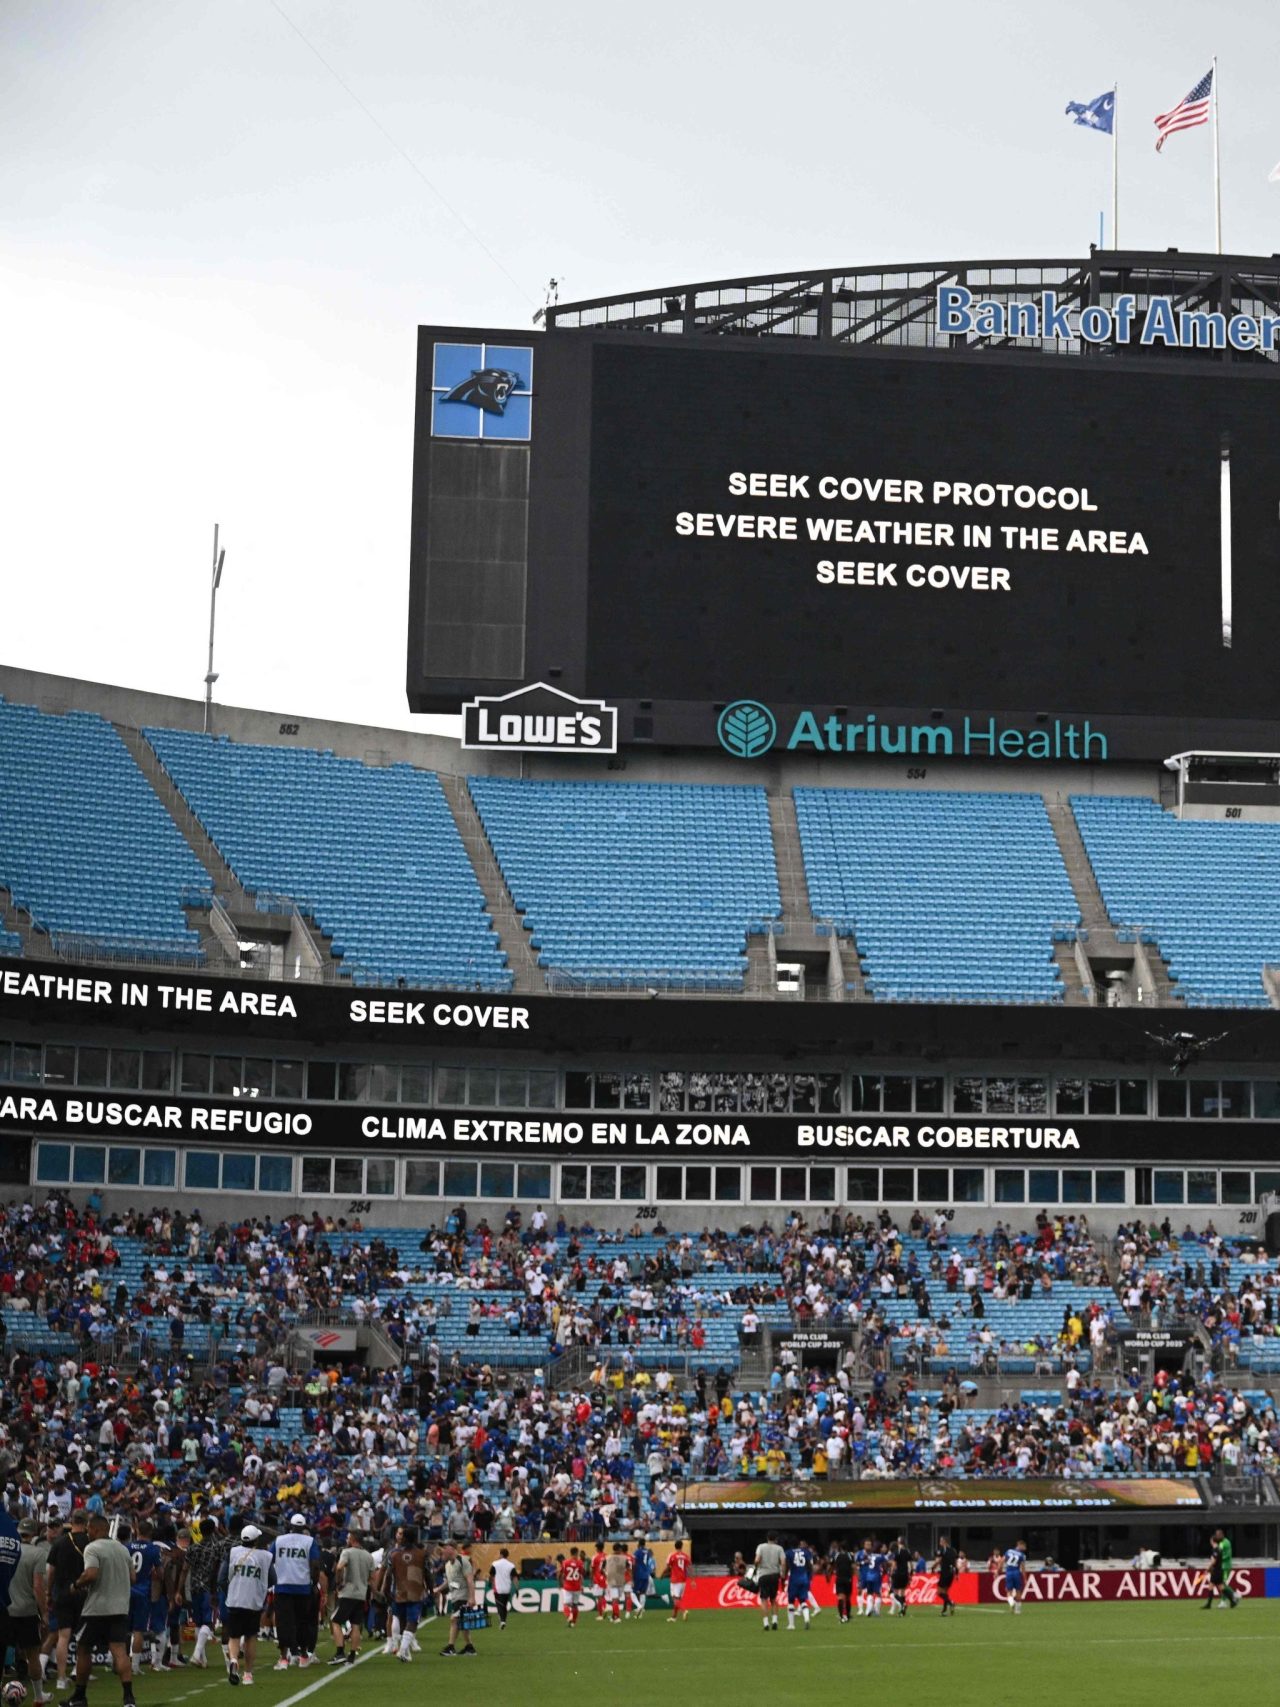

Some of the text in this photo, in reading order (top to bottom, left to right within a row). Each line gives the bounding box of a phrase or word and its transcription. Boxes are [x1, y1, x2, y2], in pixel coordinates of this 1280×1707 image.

[937, 284, 1074, 340] Bank
[1081, 294, 1136, 344] of
[729, 472, 1097, 511] SEEK COVER PROTOCOL
[676, 512, 1149, 554] SEVERE WEATHER IN THE AREA
[817, 560, 1011, 590] SEEK COVER
[478, 708, 602, 746] LOWE'S
[788, 711, 1108, 759] Atrium Health
[907, 768, 926, 779] 554
[1226, 807, 1242, 819] 501
[122, 983, 148, 1006] IN
[158, 986, 212, 1011] THE
[220, 991, 297, 1017] AREA
[350, 1000, 529, 1029] SEEK COVER
[0, 1096, 312, 1135] ARA BUSCAR REFUGIO
[362, 1116, 750, 1145] CLIMA EXTREMO EN LA ZONA
[798, 1126, 1080, 1148] BUSCAR COBERTURA
[349, 1200, 373, 1214] 254
[636, 1206, 657, 1220] 255
[1239, 1211, 1257, 1224] 201
[793, 1333, 828, 1341] FIFA CLUB
[1124, 1340, 1149, 1348] WORLD
[1150, 1340, 1164, 1348] CUP
[684, 1502, 719, 1510] CLUB
[722, 1501, 775, 1509] WORLD
[777, 1501, 807, 1509] CUP
[915, 1500, 947, 1508] FIFA
[949, 1499, 986, 1507] CLUB
[989, 1499, 1041, 1507] WORLD
[1044, 1498, 1072, 1506] CUP
[278, 1547, 307, 1559] FIFA
[793, 1551, 806, 1566] 45
[233, 1564, 262, 1579] FIFA
[678, 1558, 685, 1572] 4
[566, 1567, 580, 1581] 26
